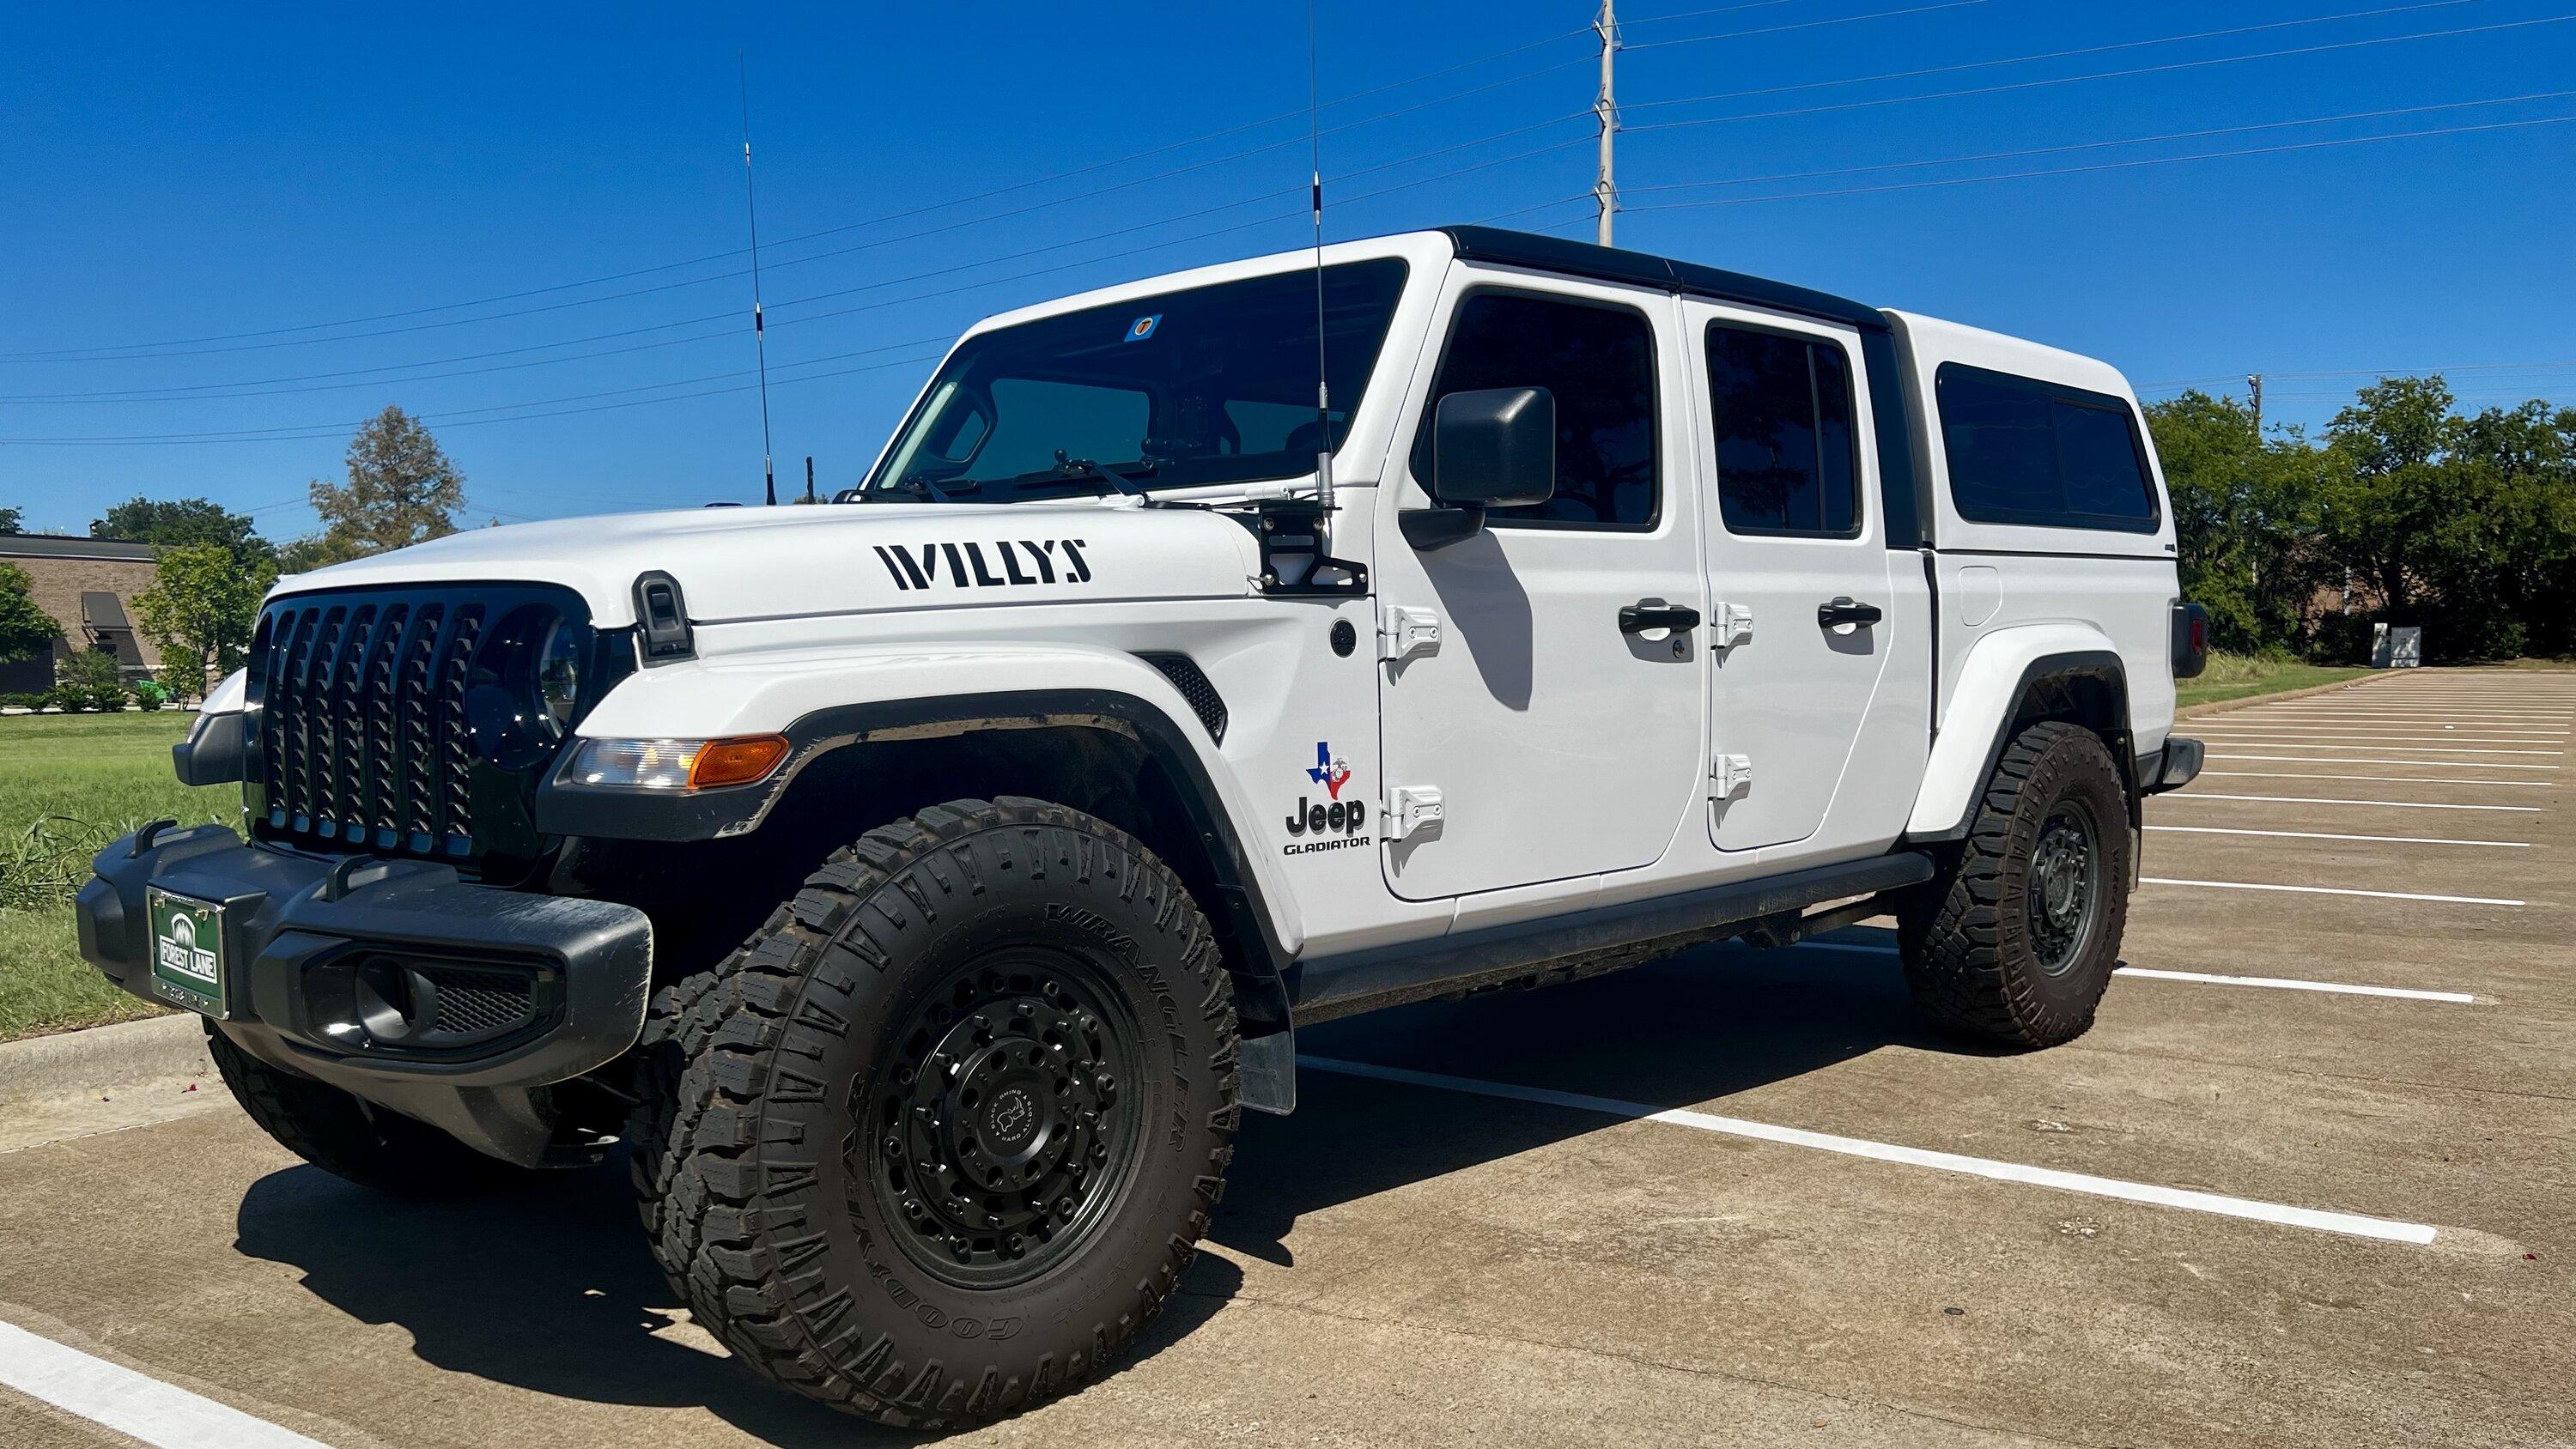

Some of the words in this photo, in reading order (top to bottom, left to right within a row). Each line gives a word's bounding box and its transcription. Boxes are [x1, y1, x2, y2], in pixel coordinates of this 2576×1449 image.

[872, 539, 1091, 590] WILLYS
[1285, 797, 1365, 835] Jeep
[1284, 837, 1370, 855] GLADIATOR
[162, 942, 189, 969] FOREST
[190, 951, 215, 978] LANE
[1046, 902, 1190, 1151] WRANGLER
[990, 1101, 999, 1130] BLACK
[999, 1089, 1021, 1100] RHINO
[1001, 1133, 1021, 1142] HARD
